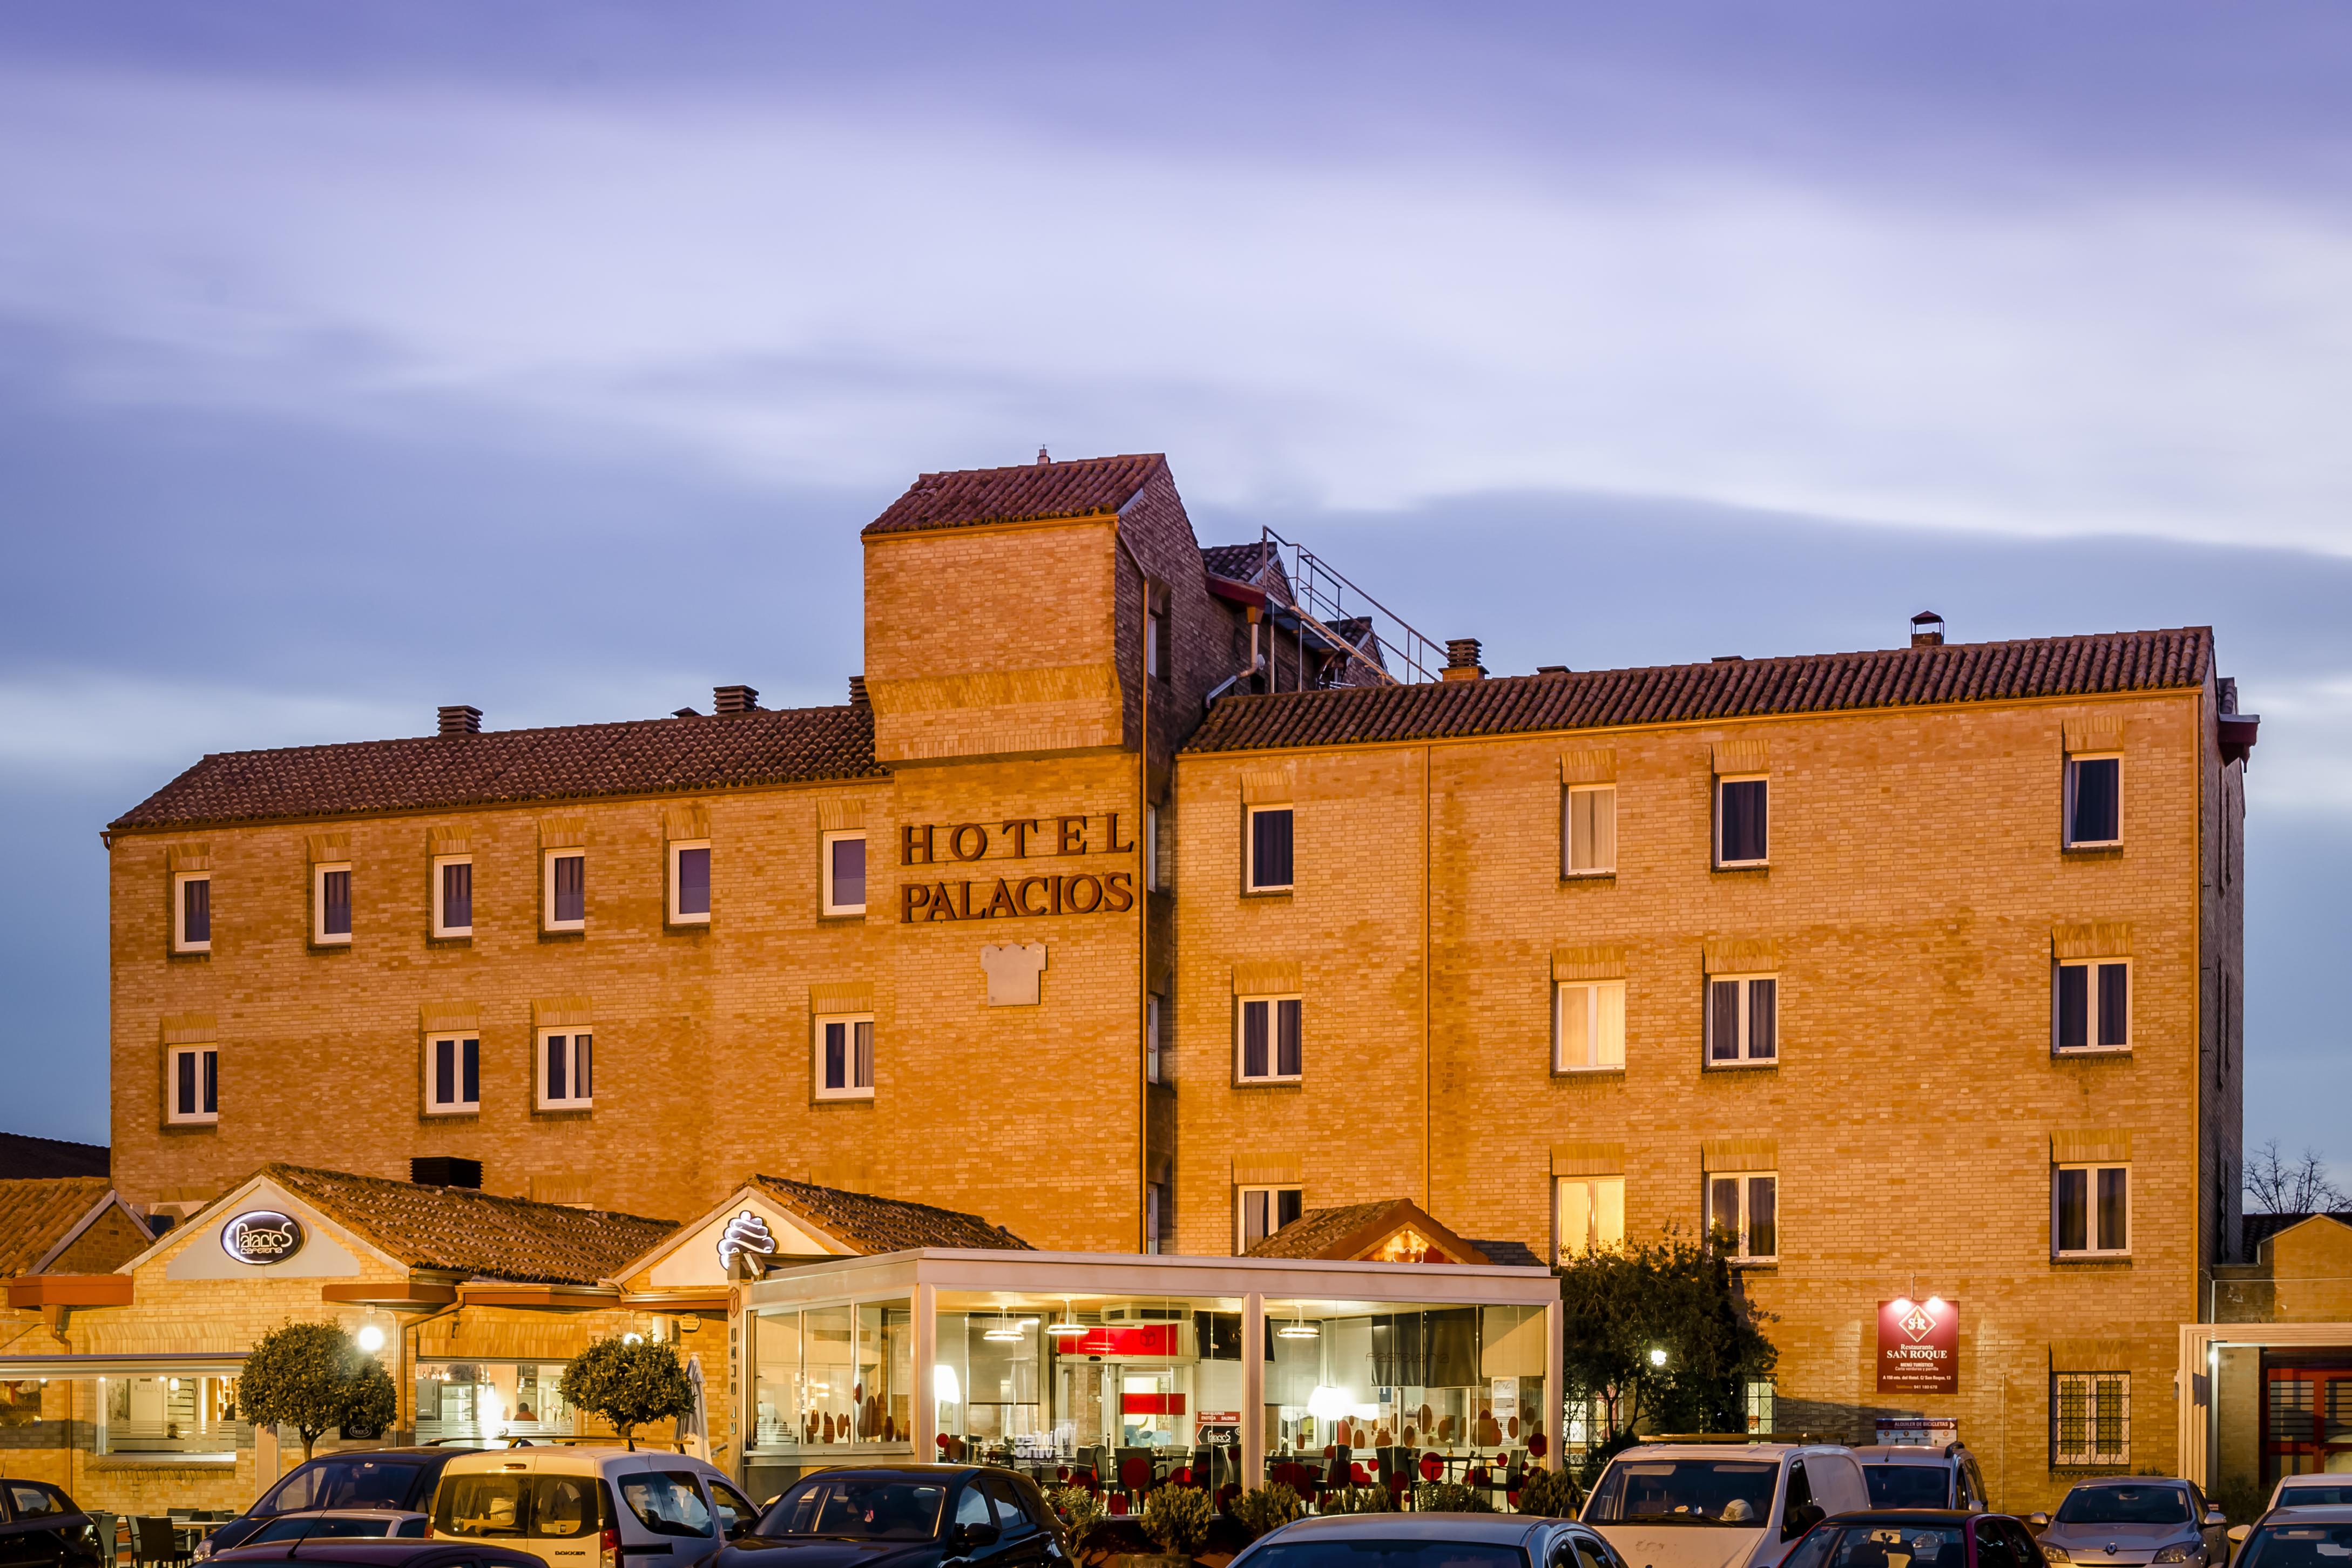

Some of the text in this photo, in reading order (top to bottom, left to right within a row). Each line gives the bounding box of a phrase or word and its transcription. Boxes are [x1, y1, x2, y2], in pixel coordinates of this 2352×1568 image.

[900, 813, 1134, 865] HOTEL
[900, 872, 1133, 923] PALACIOS
[1887, 1350, 1947, 1360] SAN ROQUE
